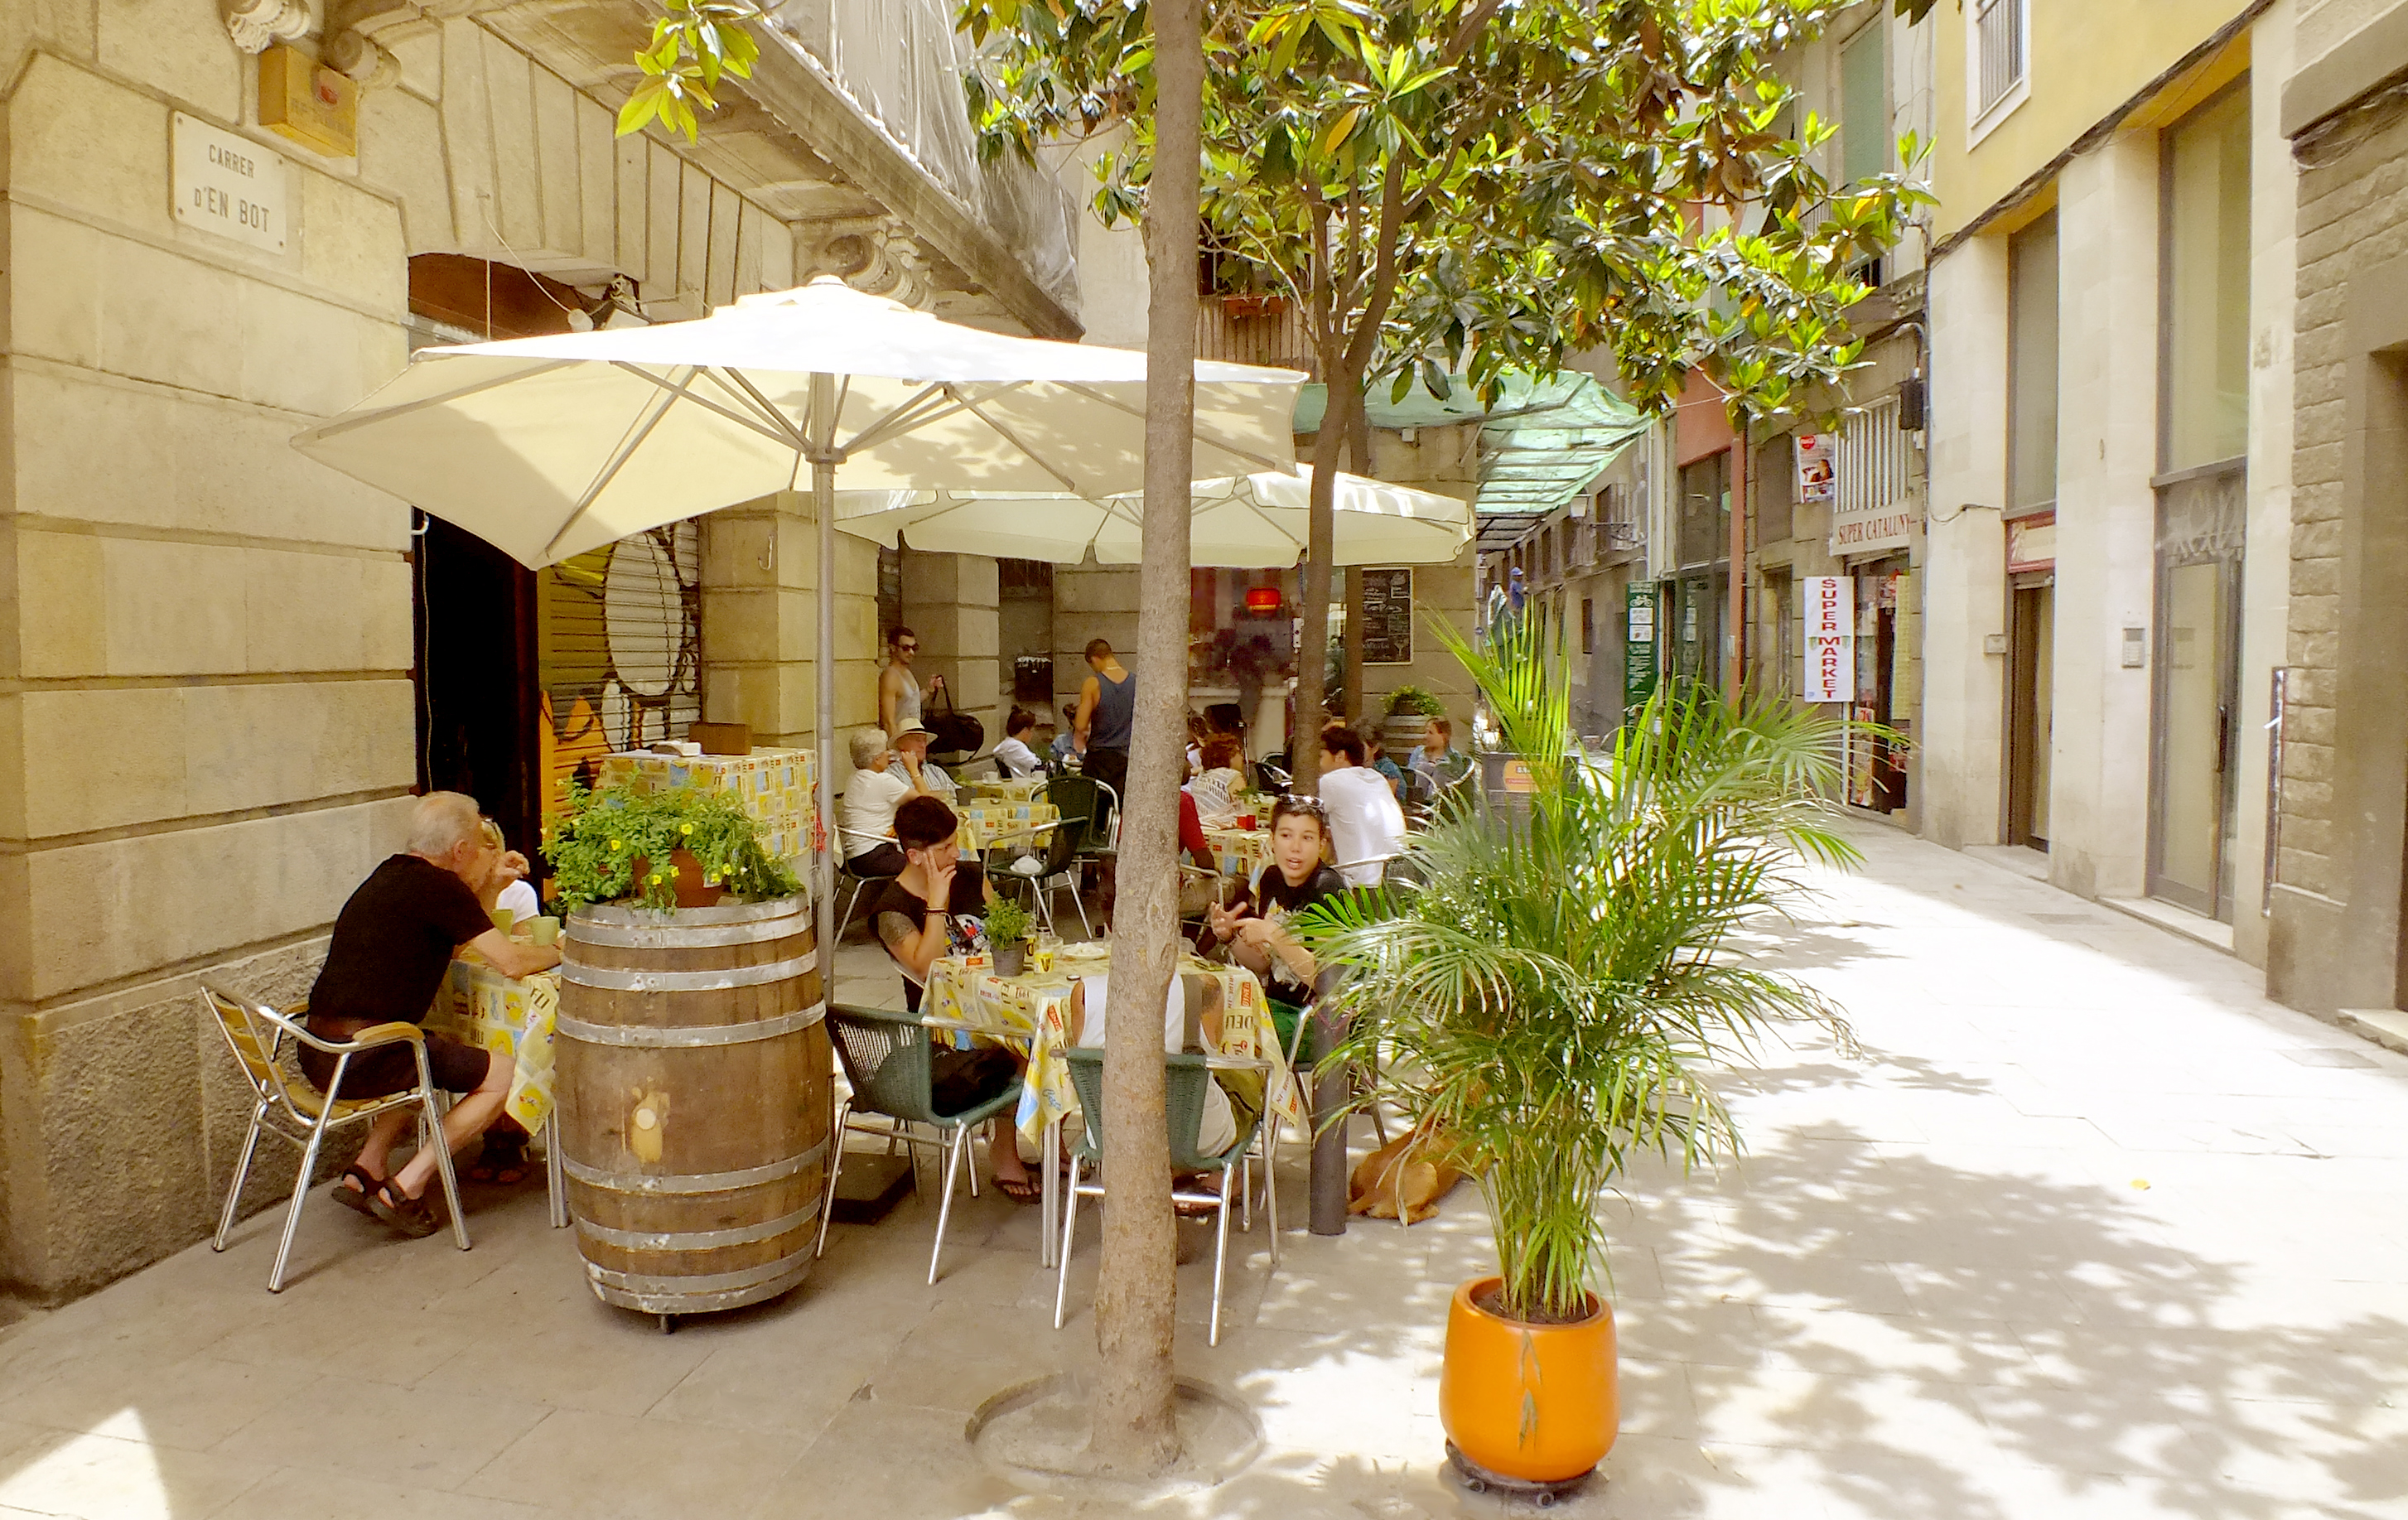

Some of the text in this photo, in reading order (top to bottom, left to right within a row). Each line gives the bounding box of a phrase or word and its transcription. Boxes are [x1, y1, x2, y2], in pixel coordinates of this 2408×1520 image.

[209, 143, 254, 178] CARRER
[194, 186, 269, 232] D'EN BOT
[1838, 522, 1863, 544] SUPER
[1818, 578, 1840, 698] SUPER MARKET
